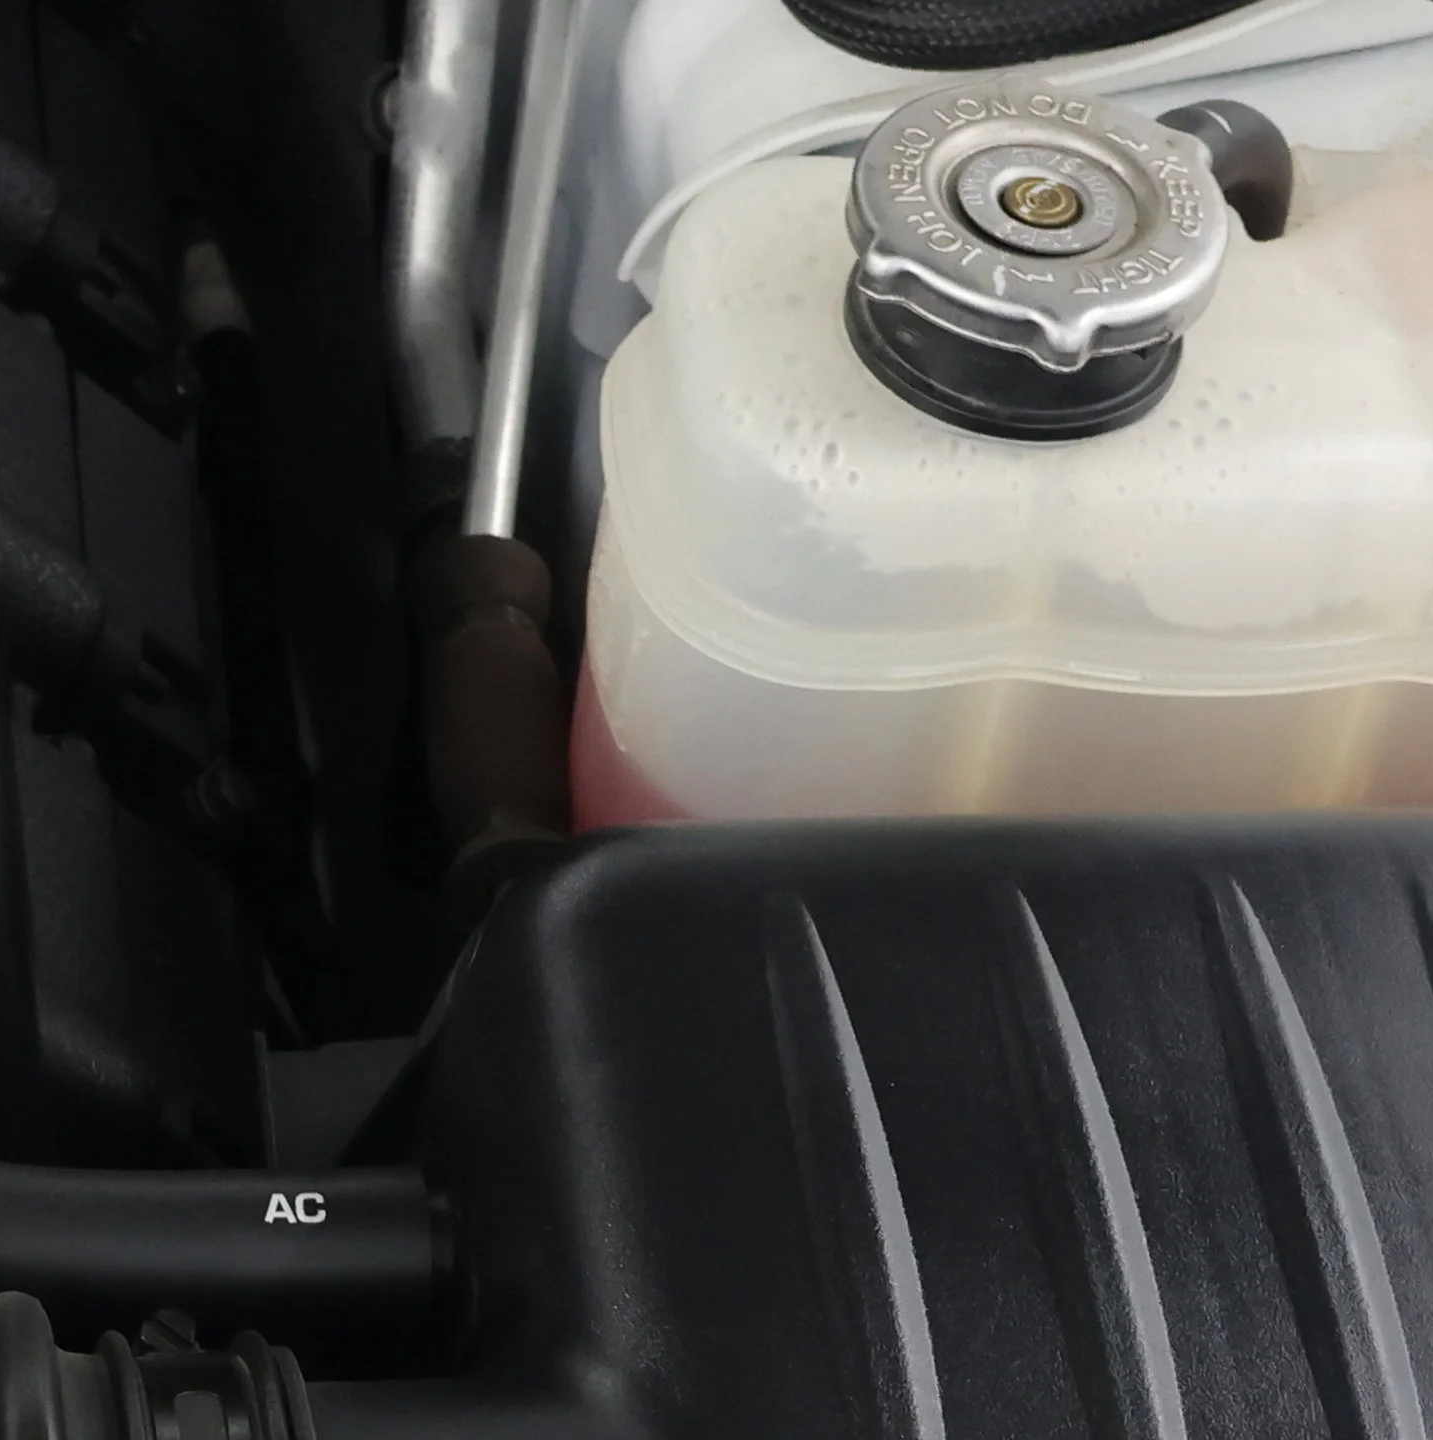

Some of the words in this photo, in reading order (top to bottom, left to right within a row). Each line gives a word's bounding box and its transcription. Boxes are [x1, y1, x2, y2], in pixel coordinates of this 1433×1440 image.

[934, 97, 1019, 131] NOT
[1028, 93, 1093, 126] DO
[887, 126, 936, 203] OPEN
[1151, 155, 1206, 240] KEEP
[906, 209, 984, 267] HOT
[1073, 249, 1185, 296] TIGHT
[264, 1192, 327, 1224] AC
